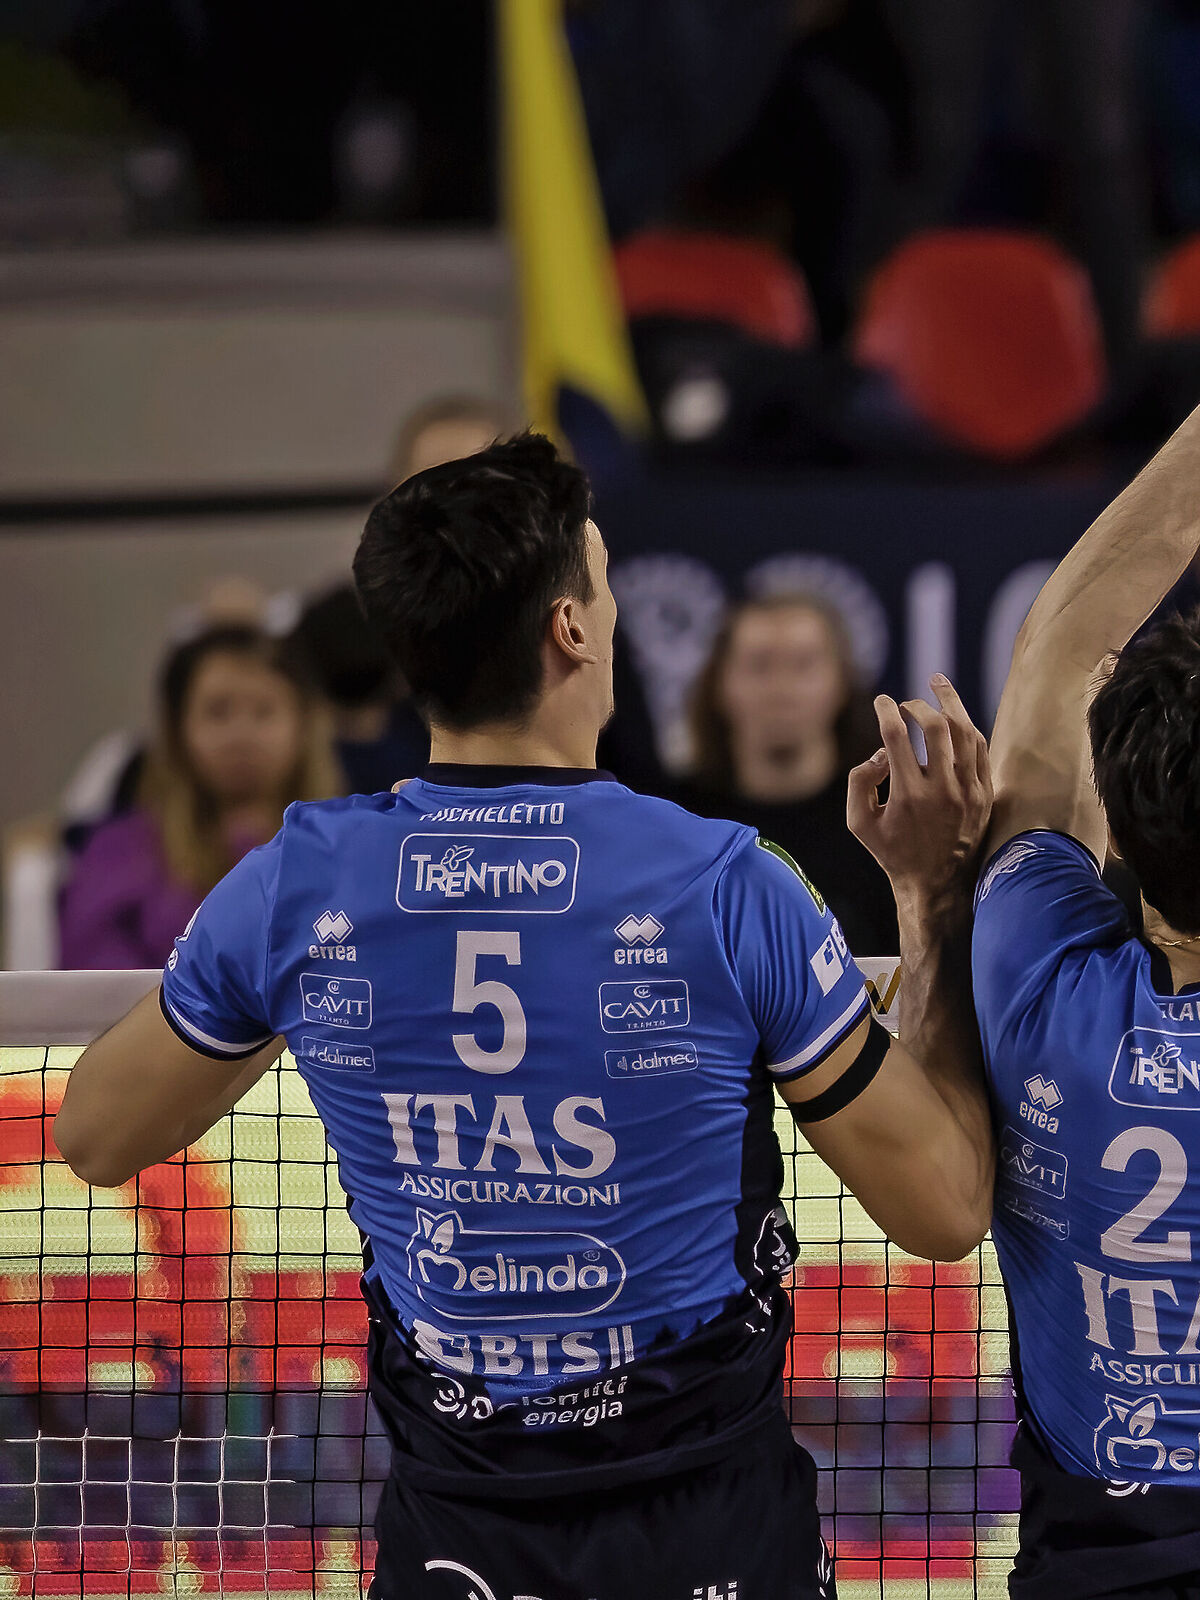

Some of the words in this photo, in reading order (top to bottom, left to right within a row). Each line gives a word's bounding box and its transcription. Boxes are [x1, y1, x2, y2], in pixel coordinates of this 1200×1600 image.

[411, 854, 567, 898] TRENTINO
[308, 945, 357, 962] errea
[614, 948, 668, 964] errea
[305, 992, 359, 1016] CAVIT
[453, 931, 527, 1074] 5
[603, 997, 685, 1019] CAVIT
[317, 1046, 373, 1067] dalmec
[631, 1051, 697, 1071] dalmec
[1019, 1101, 1060, 1134] errea
[381, 1093, 617, 1179] ITAS
[1001, 1147, 1064, 1185] CAVIT
[398, 1171, 620, 1207] ASSICURAZIONI
[416, 1247, 609, 1293] Melinda
[480, 1331, 601, 1376] BTS
[522, 1399, 624, 1427] energia
